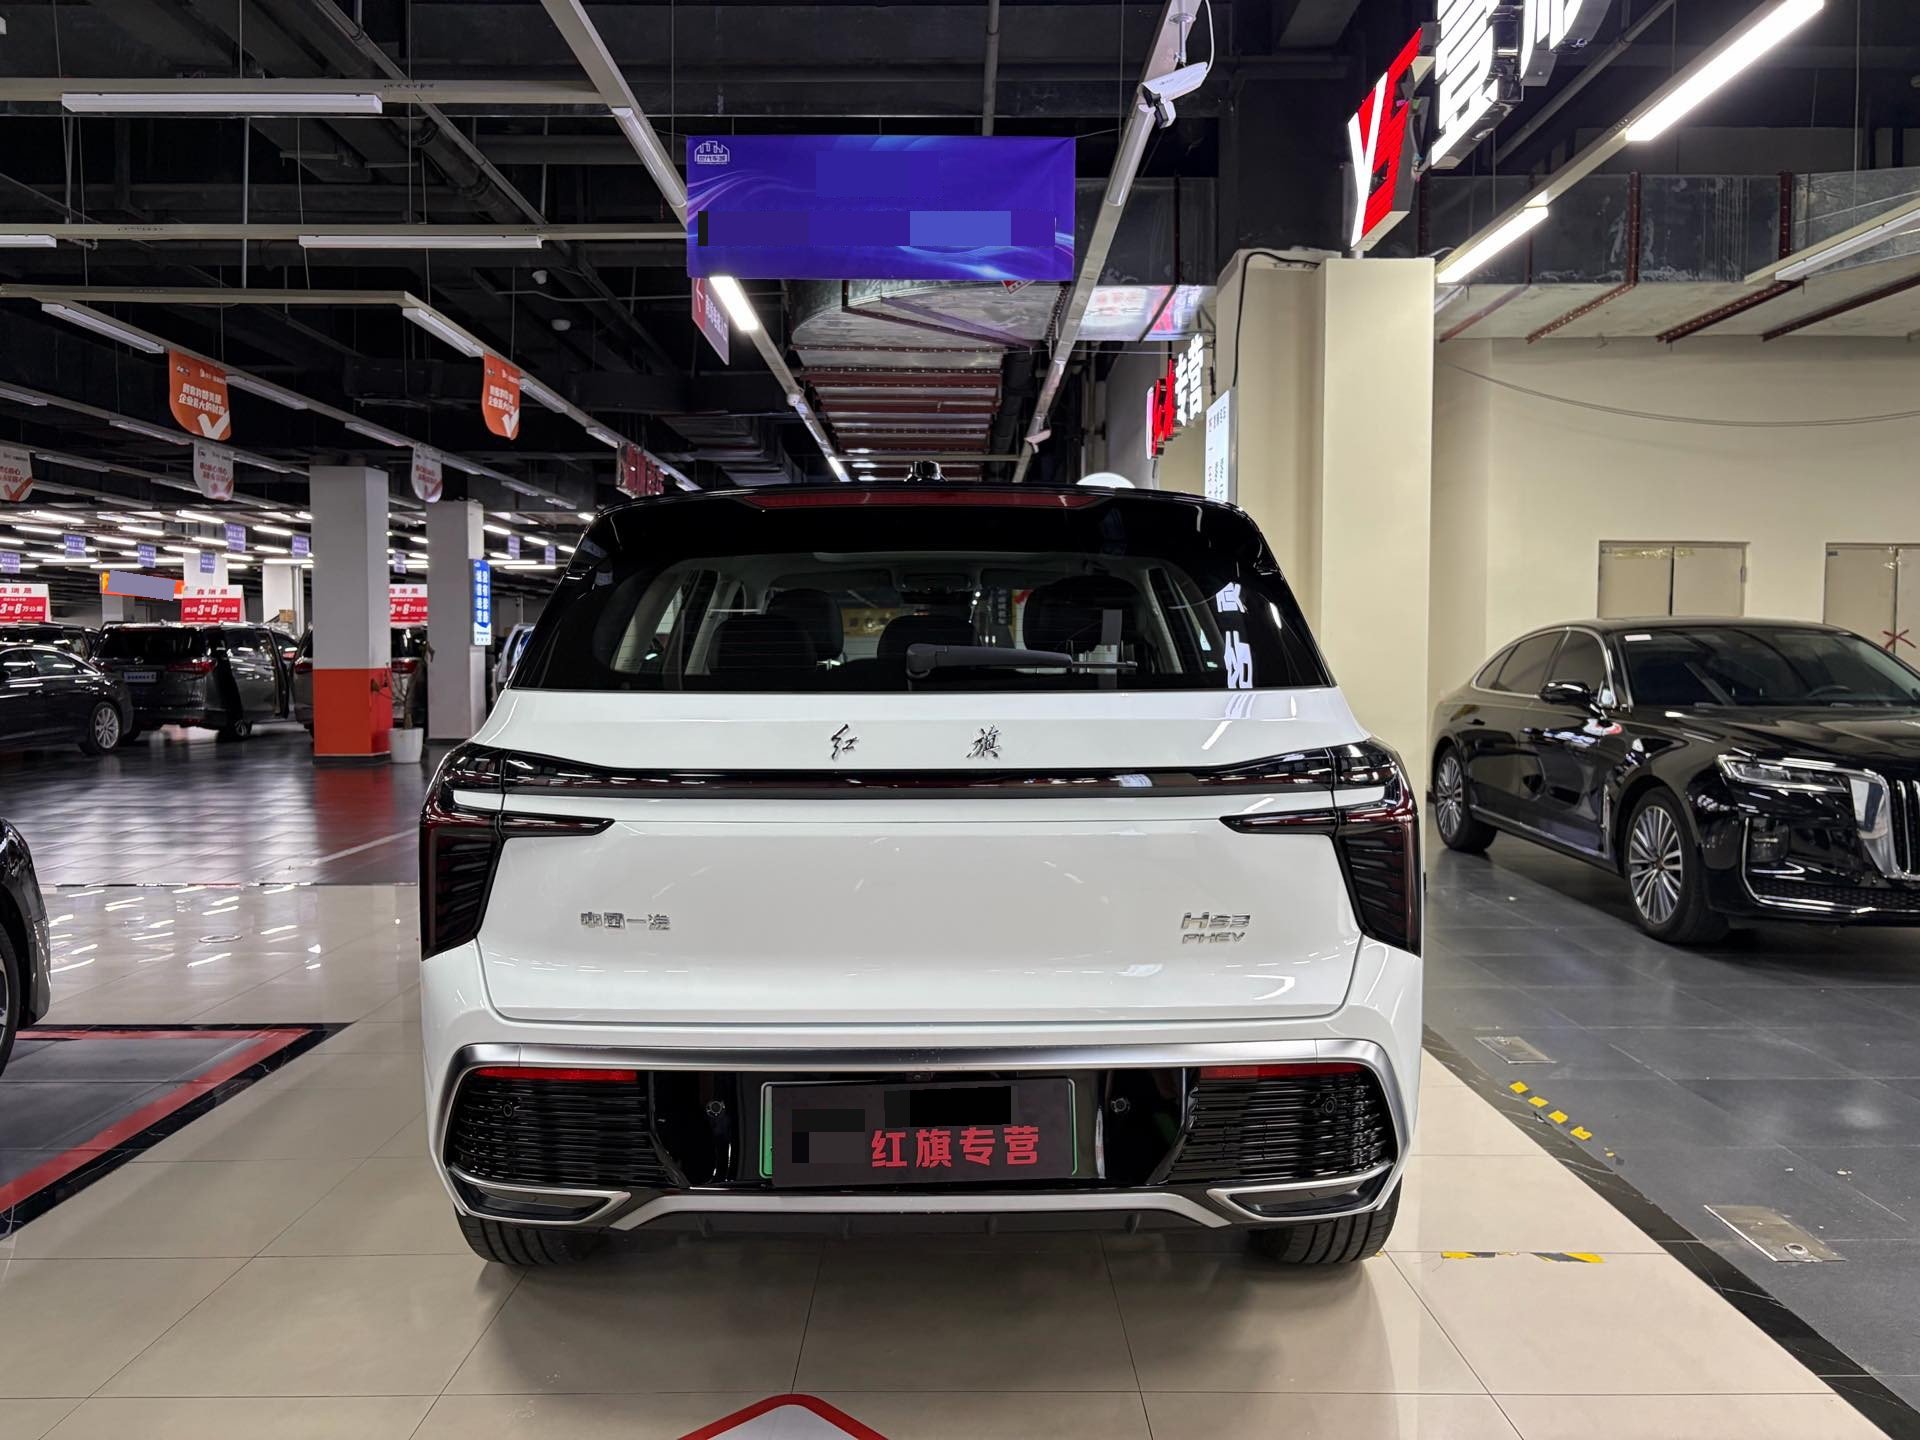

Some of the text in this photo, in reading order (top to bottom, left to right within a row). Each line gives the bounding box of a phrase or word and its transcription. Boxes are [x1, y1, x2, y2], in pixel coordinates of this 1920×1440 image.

[1181, 911, 1252, 929] HS3
[1182, 931, 1246, 945] PHEV
[871, 1125, 1040, 1168] 红旗专营
